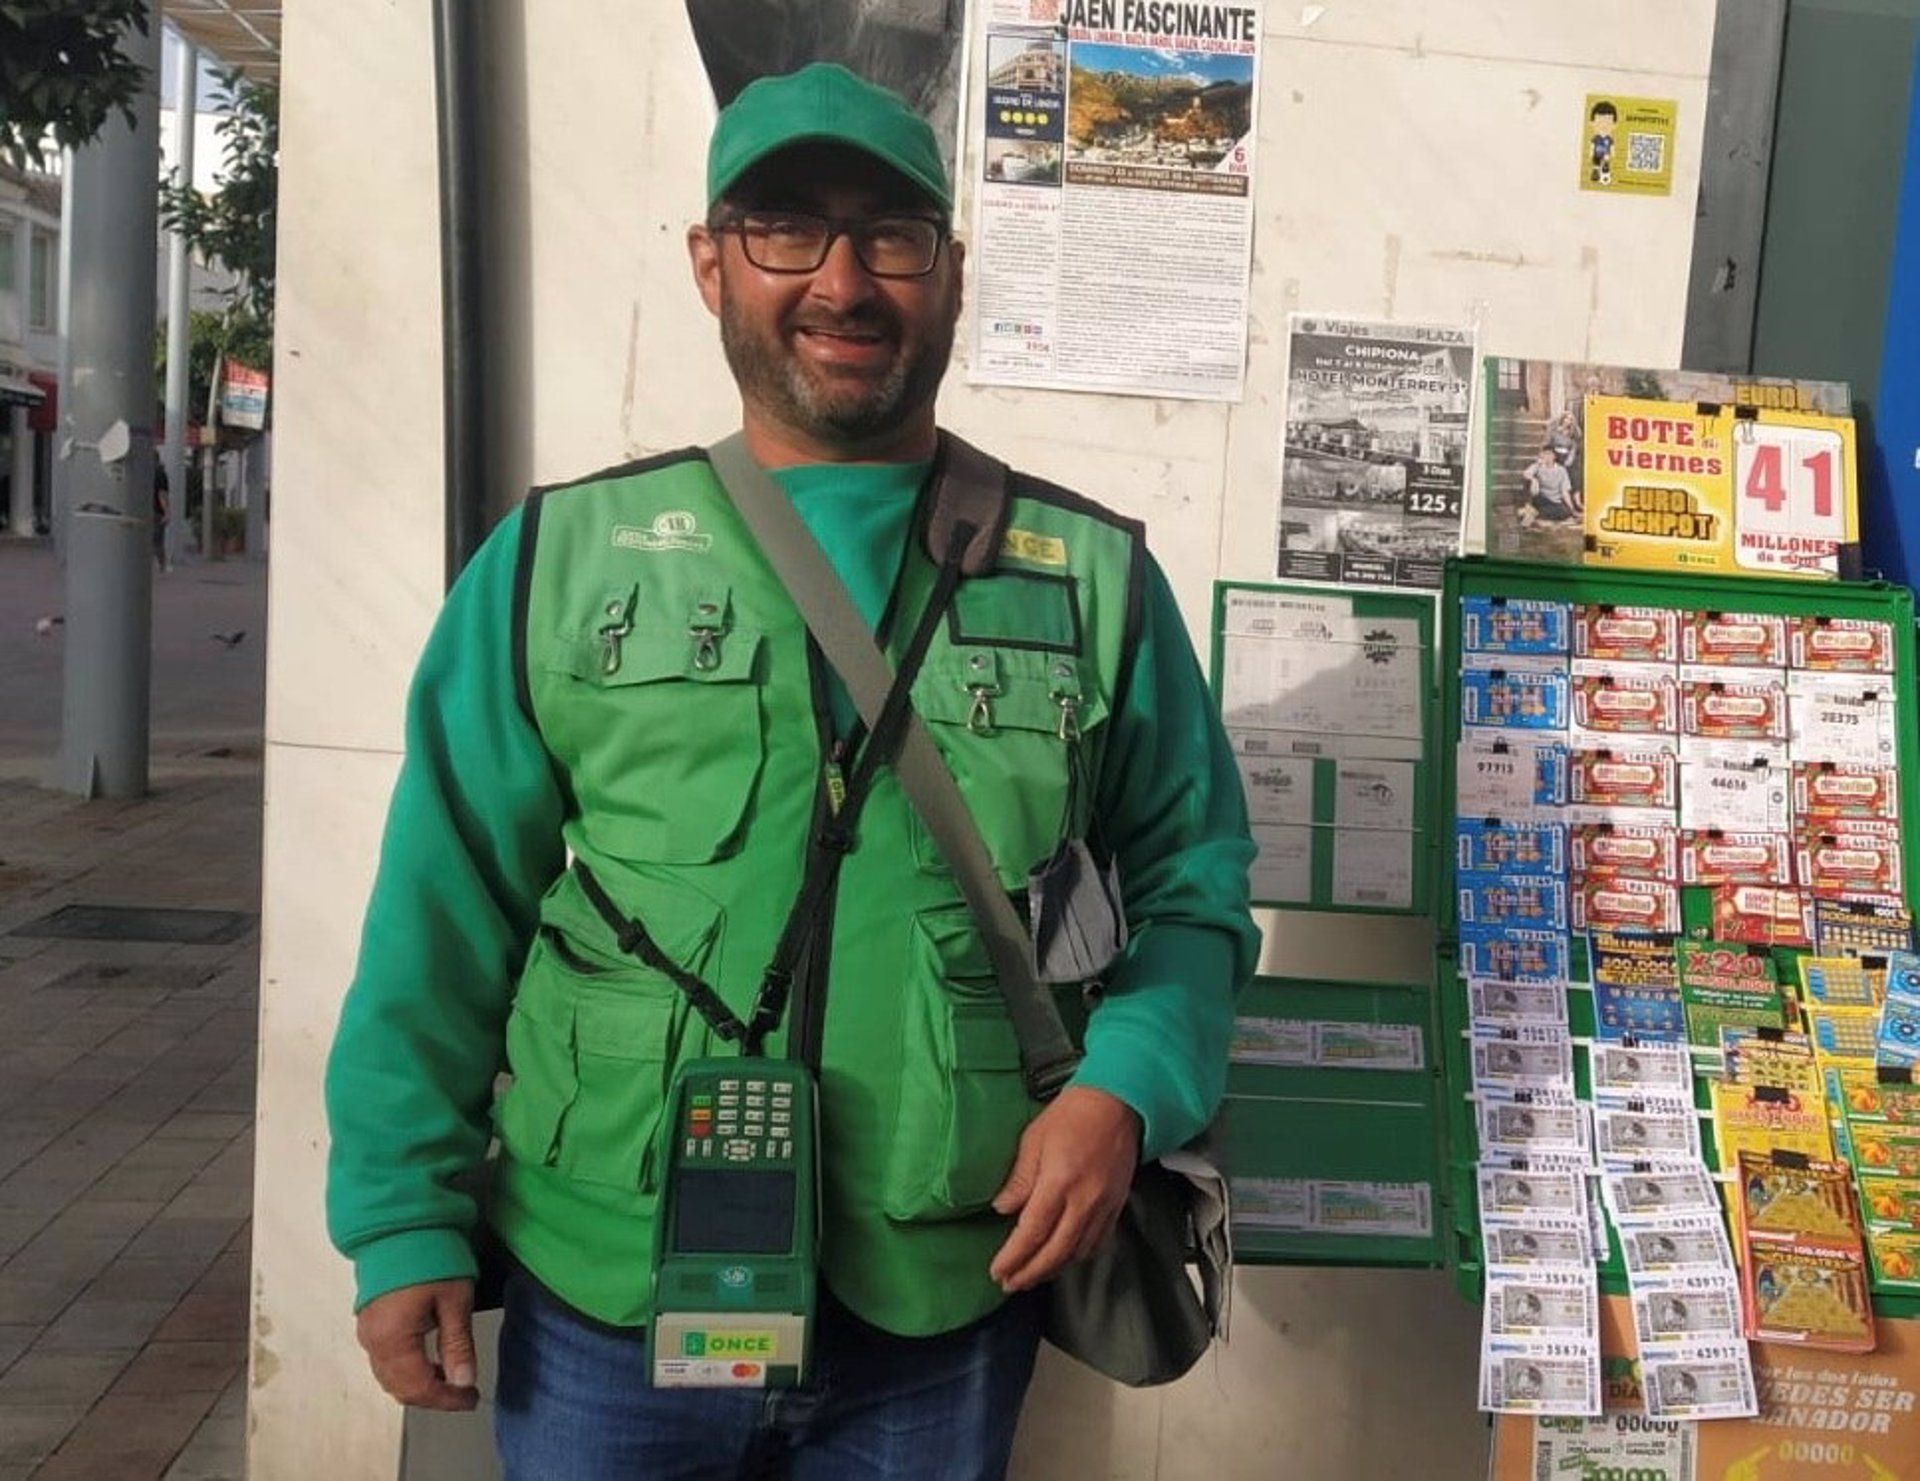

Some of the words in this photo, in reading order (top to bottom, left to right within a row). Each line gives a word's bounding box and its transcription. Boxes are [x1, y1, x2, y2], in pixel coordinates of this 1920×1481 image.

[1123, 0, 1255, 40] FASCINANTE
[1324, 320, 1369, 336] Viajes
[1416, 328, 1465, 343] PLAZA
[1345, 344, 1420, 361] CHIPIONA
[1353, 371, 1447, 393] MONTERREY
[1608, 416, 1694, 446] BOTE
[1608, 444, 1722, 475] viernes
[1744, 444, 1834, 518] 41
[1409, 493, 1447, 513] 125
[1624, 486, 1689, 513] EURO
[1600, 506, 1714, 541] JACKPOT
[1740, 532, 1841, 556] MILLONES
[710, 1337, 771, 1352] ONCE
[1855, 1388, 1916, 1413] SER
[1779, 1439, 1855, 1465] 00000
